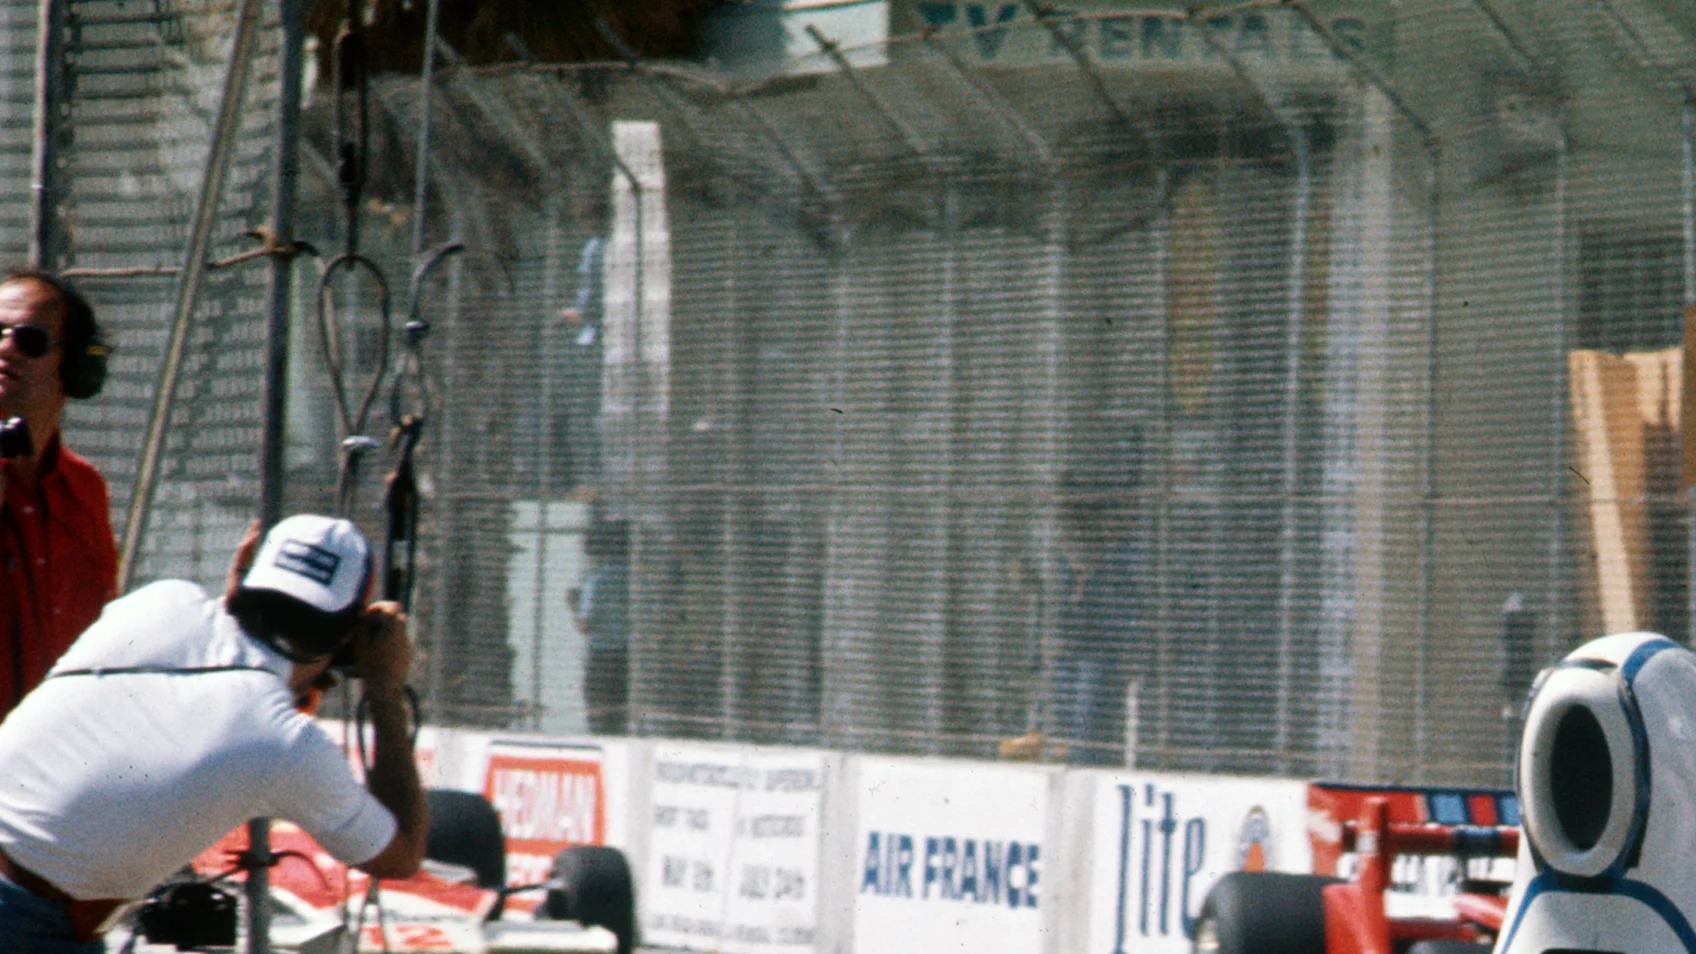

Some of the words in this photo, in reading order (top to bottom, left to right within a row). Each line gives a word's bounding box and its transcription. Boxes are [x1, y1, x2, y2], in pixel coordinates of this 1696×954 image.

[1046, 12, 1372, 60] RENTALS
[493, 768, 597, 844] HEDMAN
[859, 832, 915, 898] AIR
[922, 836, 1041, 909] FRANCE
